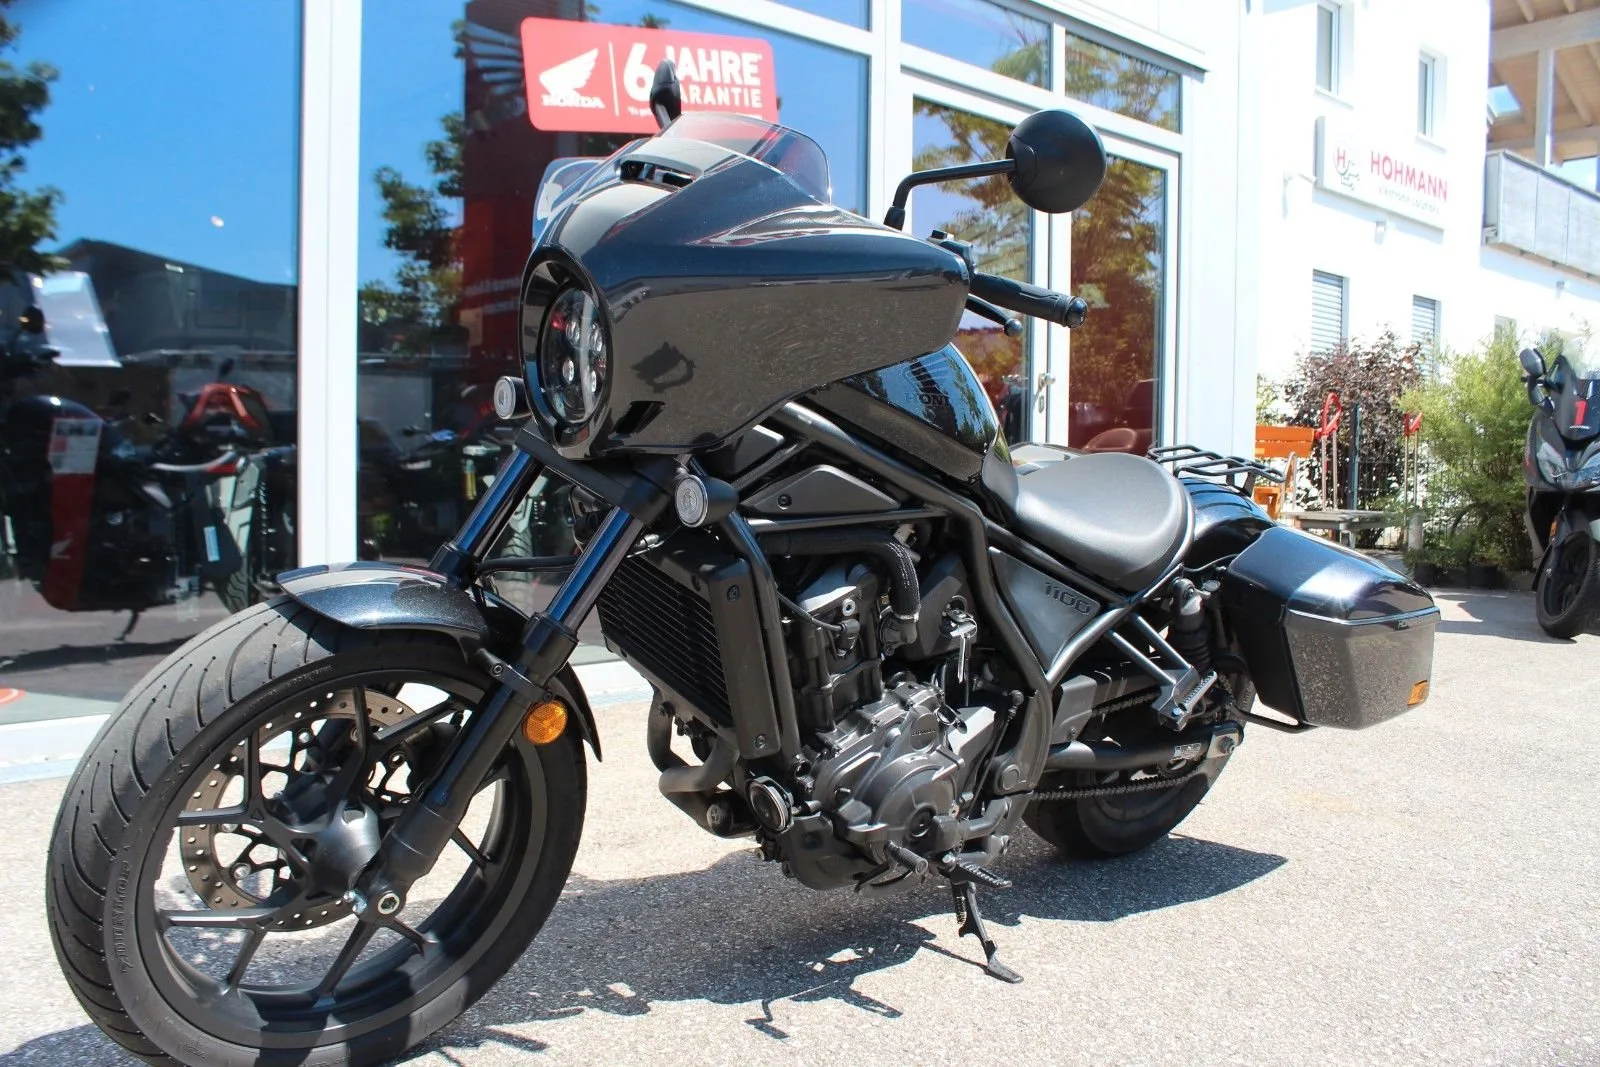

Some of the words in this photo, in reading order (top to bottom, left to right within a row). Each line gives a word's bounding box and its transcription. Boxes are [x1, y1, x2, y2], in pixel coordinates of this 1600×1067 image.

[623, 42, 656, 102] 6
[680, 84, 763, 108] ARANTIE
[1370, 150, 1447, 202] HOHMANN
[1045, 582, 1091, 614] 1100
